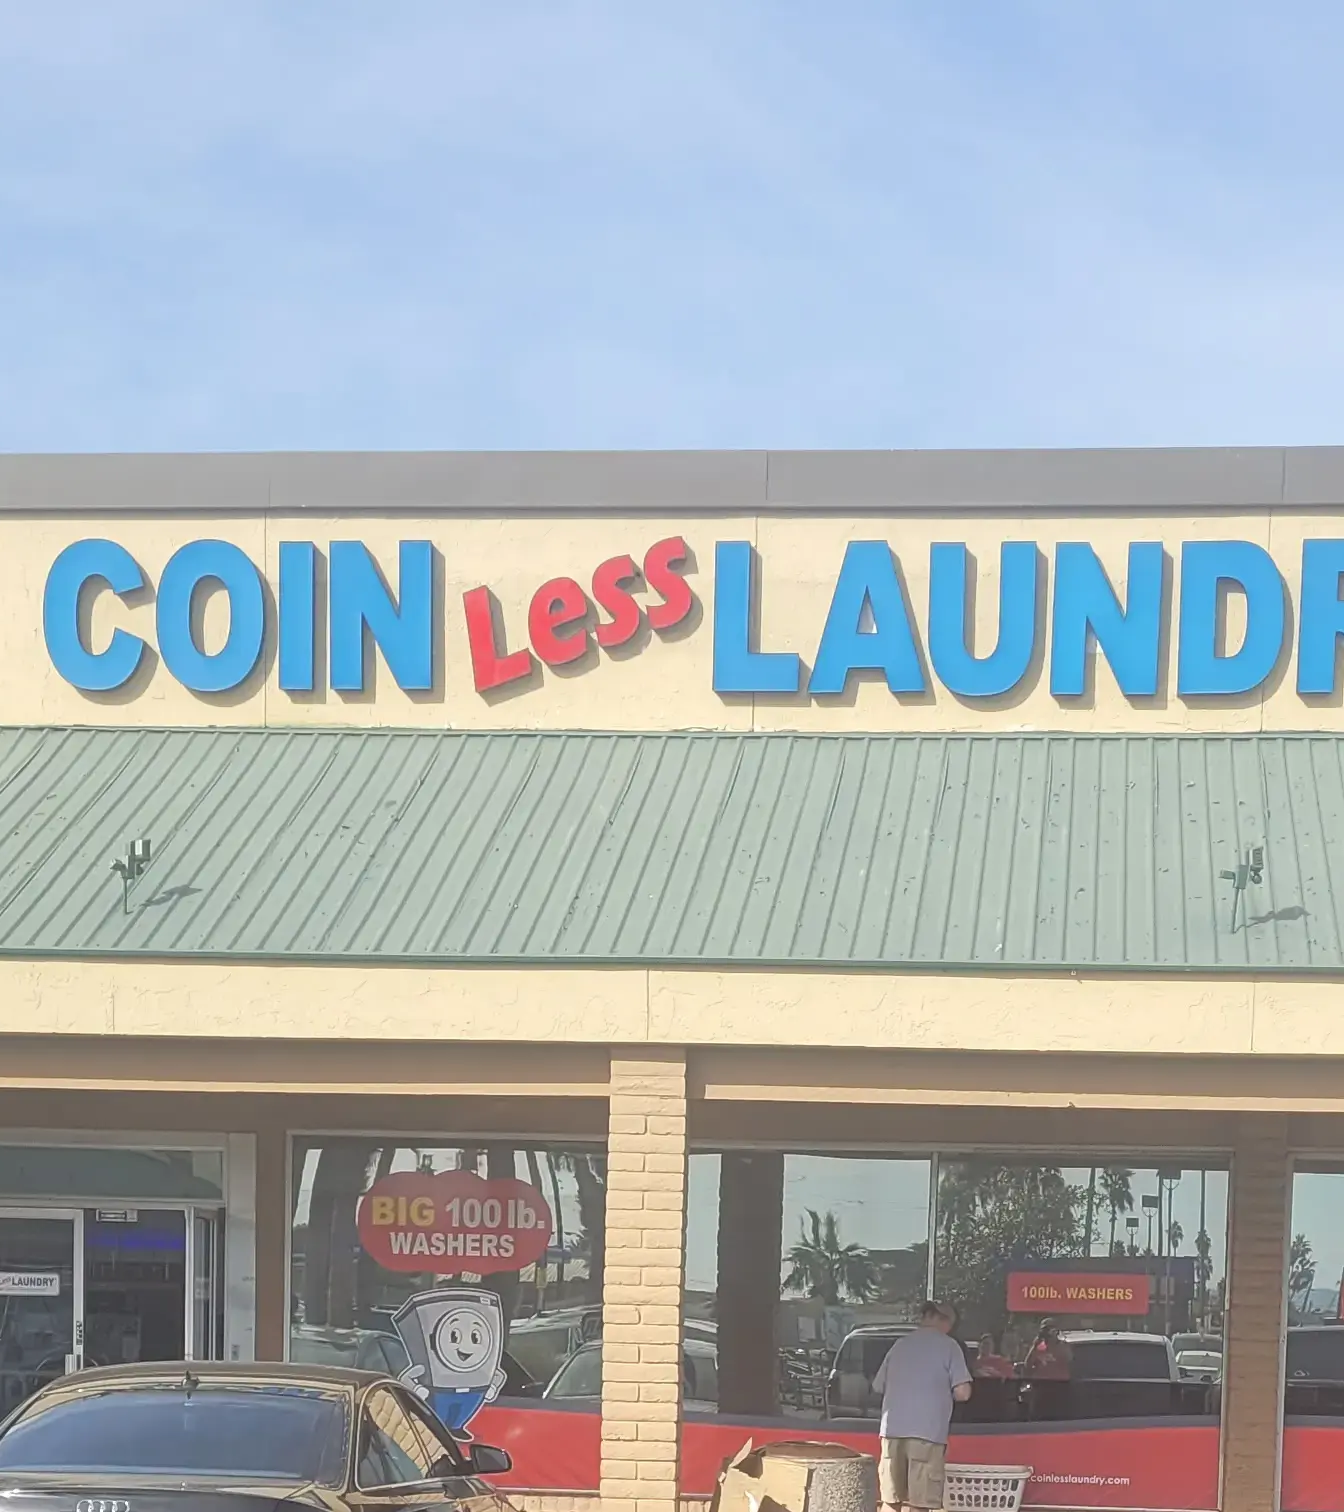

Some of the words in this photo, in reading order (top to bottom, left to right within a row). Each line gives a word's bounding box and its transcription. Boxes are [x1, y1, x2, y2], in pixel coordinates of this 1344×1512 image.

[42, 537, 435, 692] COIN
[462, 535, 691, 693] Less
[371, 1196, 436, 1227] BIG
[445, 1197, 501, 1228] 100
[507, 1199, 545, 1229] lb.
[389, 1231, 515, 1257] WASHERS
[11, 1277, 54, 1287] LAUNDRY
[1021, 1286, 1062, 1299] 100lb.
[1066, 1287, 1134, 1300] WASHERS
